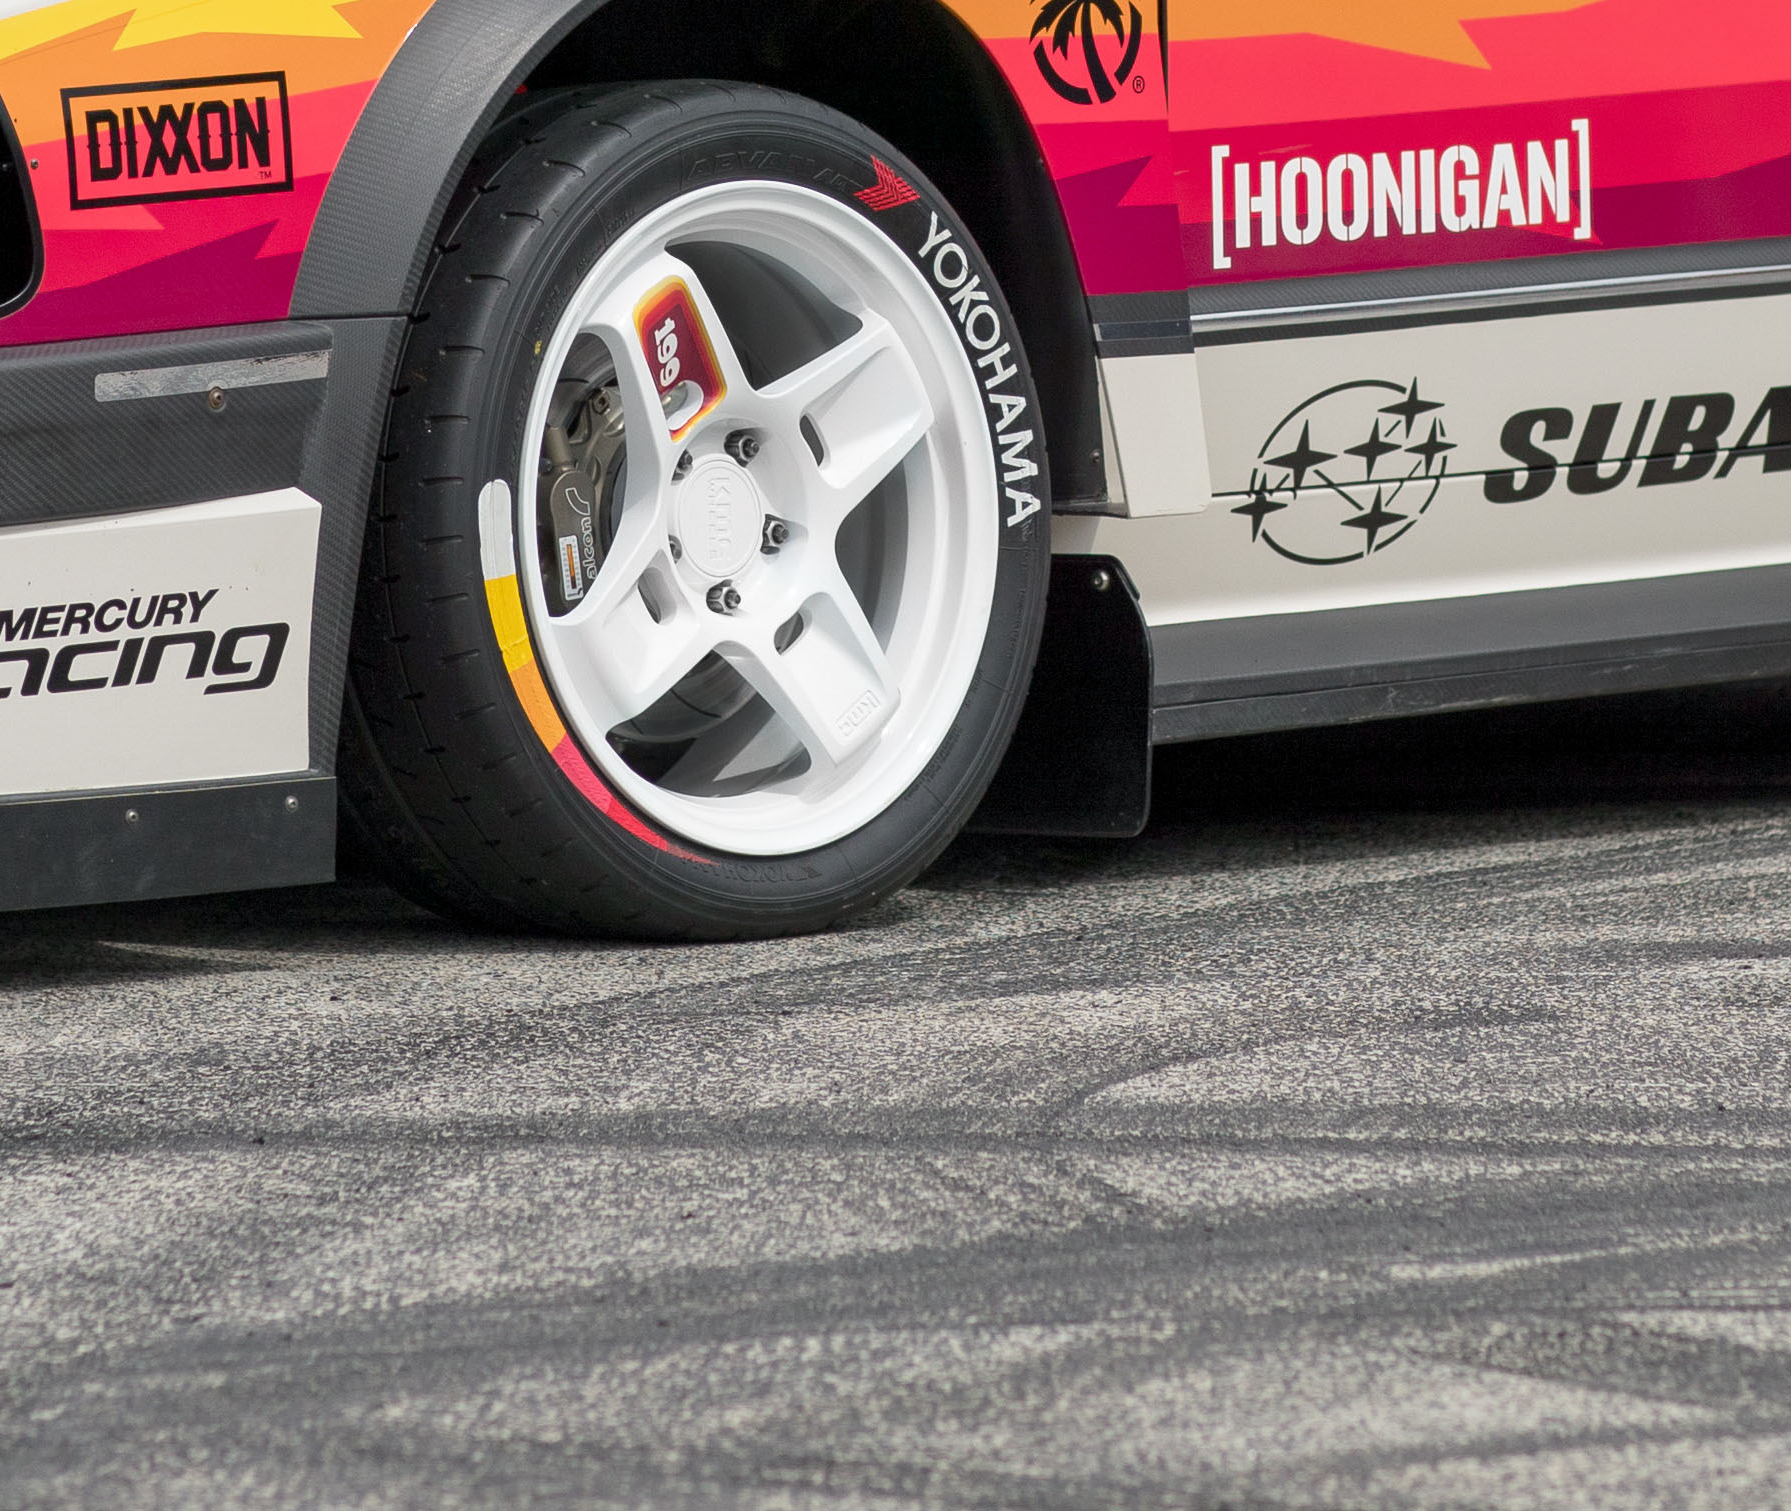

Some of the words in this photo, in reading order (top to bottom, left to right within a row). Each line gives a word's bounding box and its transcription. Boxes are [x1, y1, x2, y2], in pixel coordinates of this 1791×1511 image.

[85, 95, 271, 183] DIXXON
[653, 316, 681, 388] 199
[917, 209, 1042, 529] YOKOHAMA
